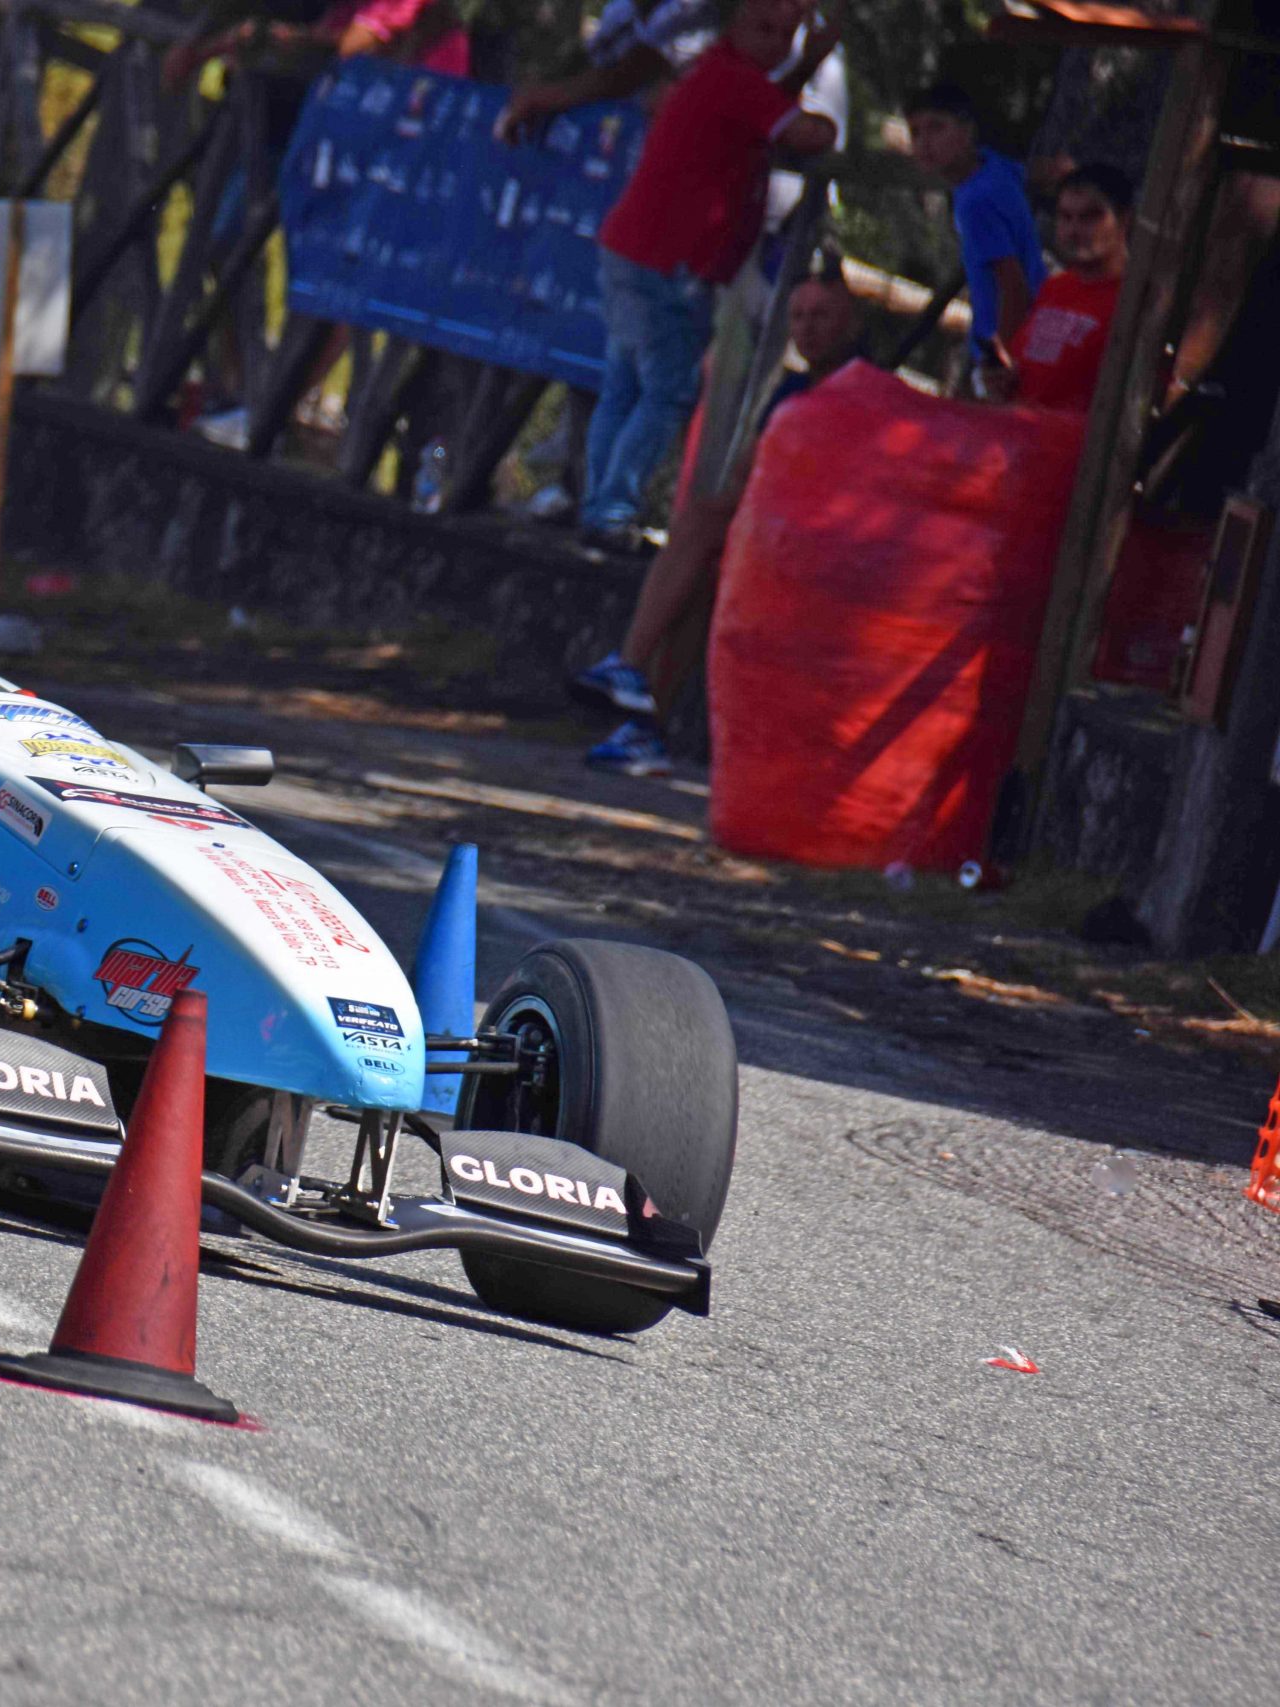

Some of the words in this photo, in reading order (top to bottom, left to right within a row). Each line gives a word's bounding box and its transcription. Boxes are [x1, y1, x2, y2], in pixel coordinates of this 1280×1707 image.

[342, 1031, 402, 1051] VASTA
[363, 1058, 399, 1072] BELL
[449, 1154, 629, 1215] GLORIA
